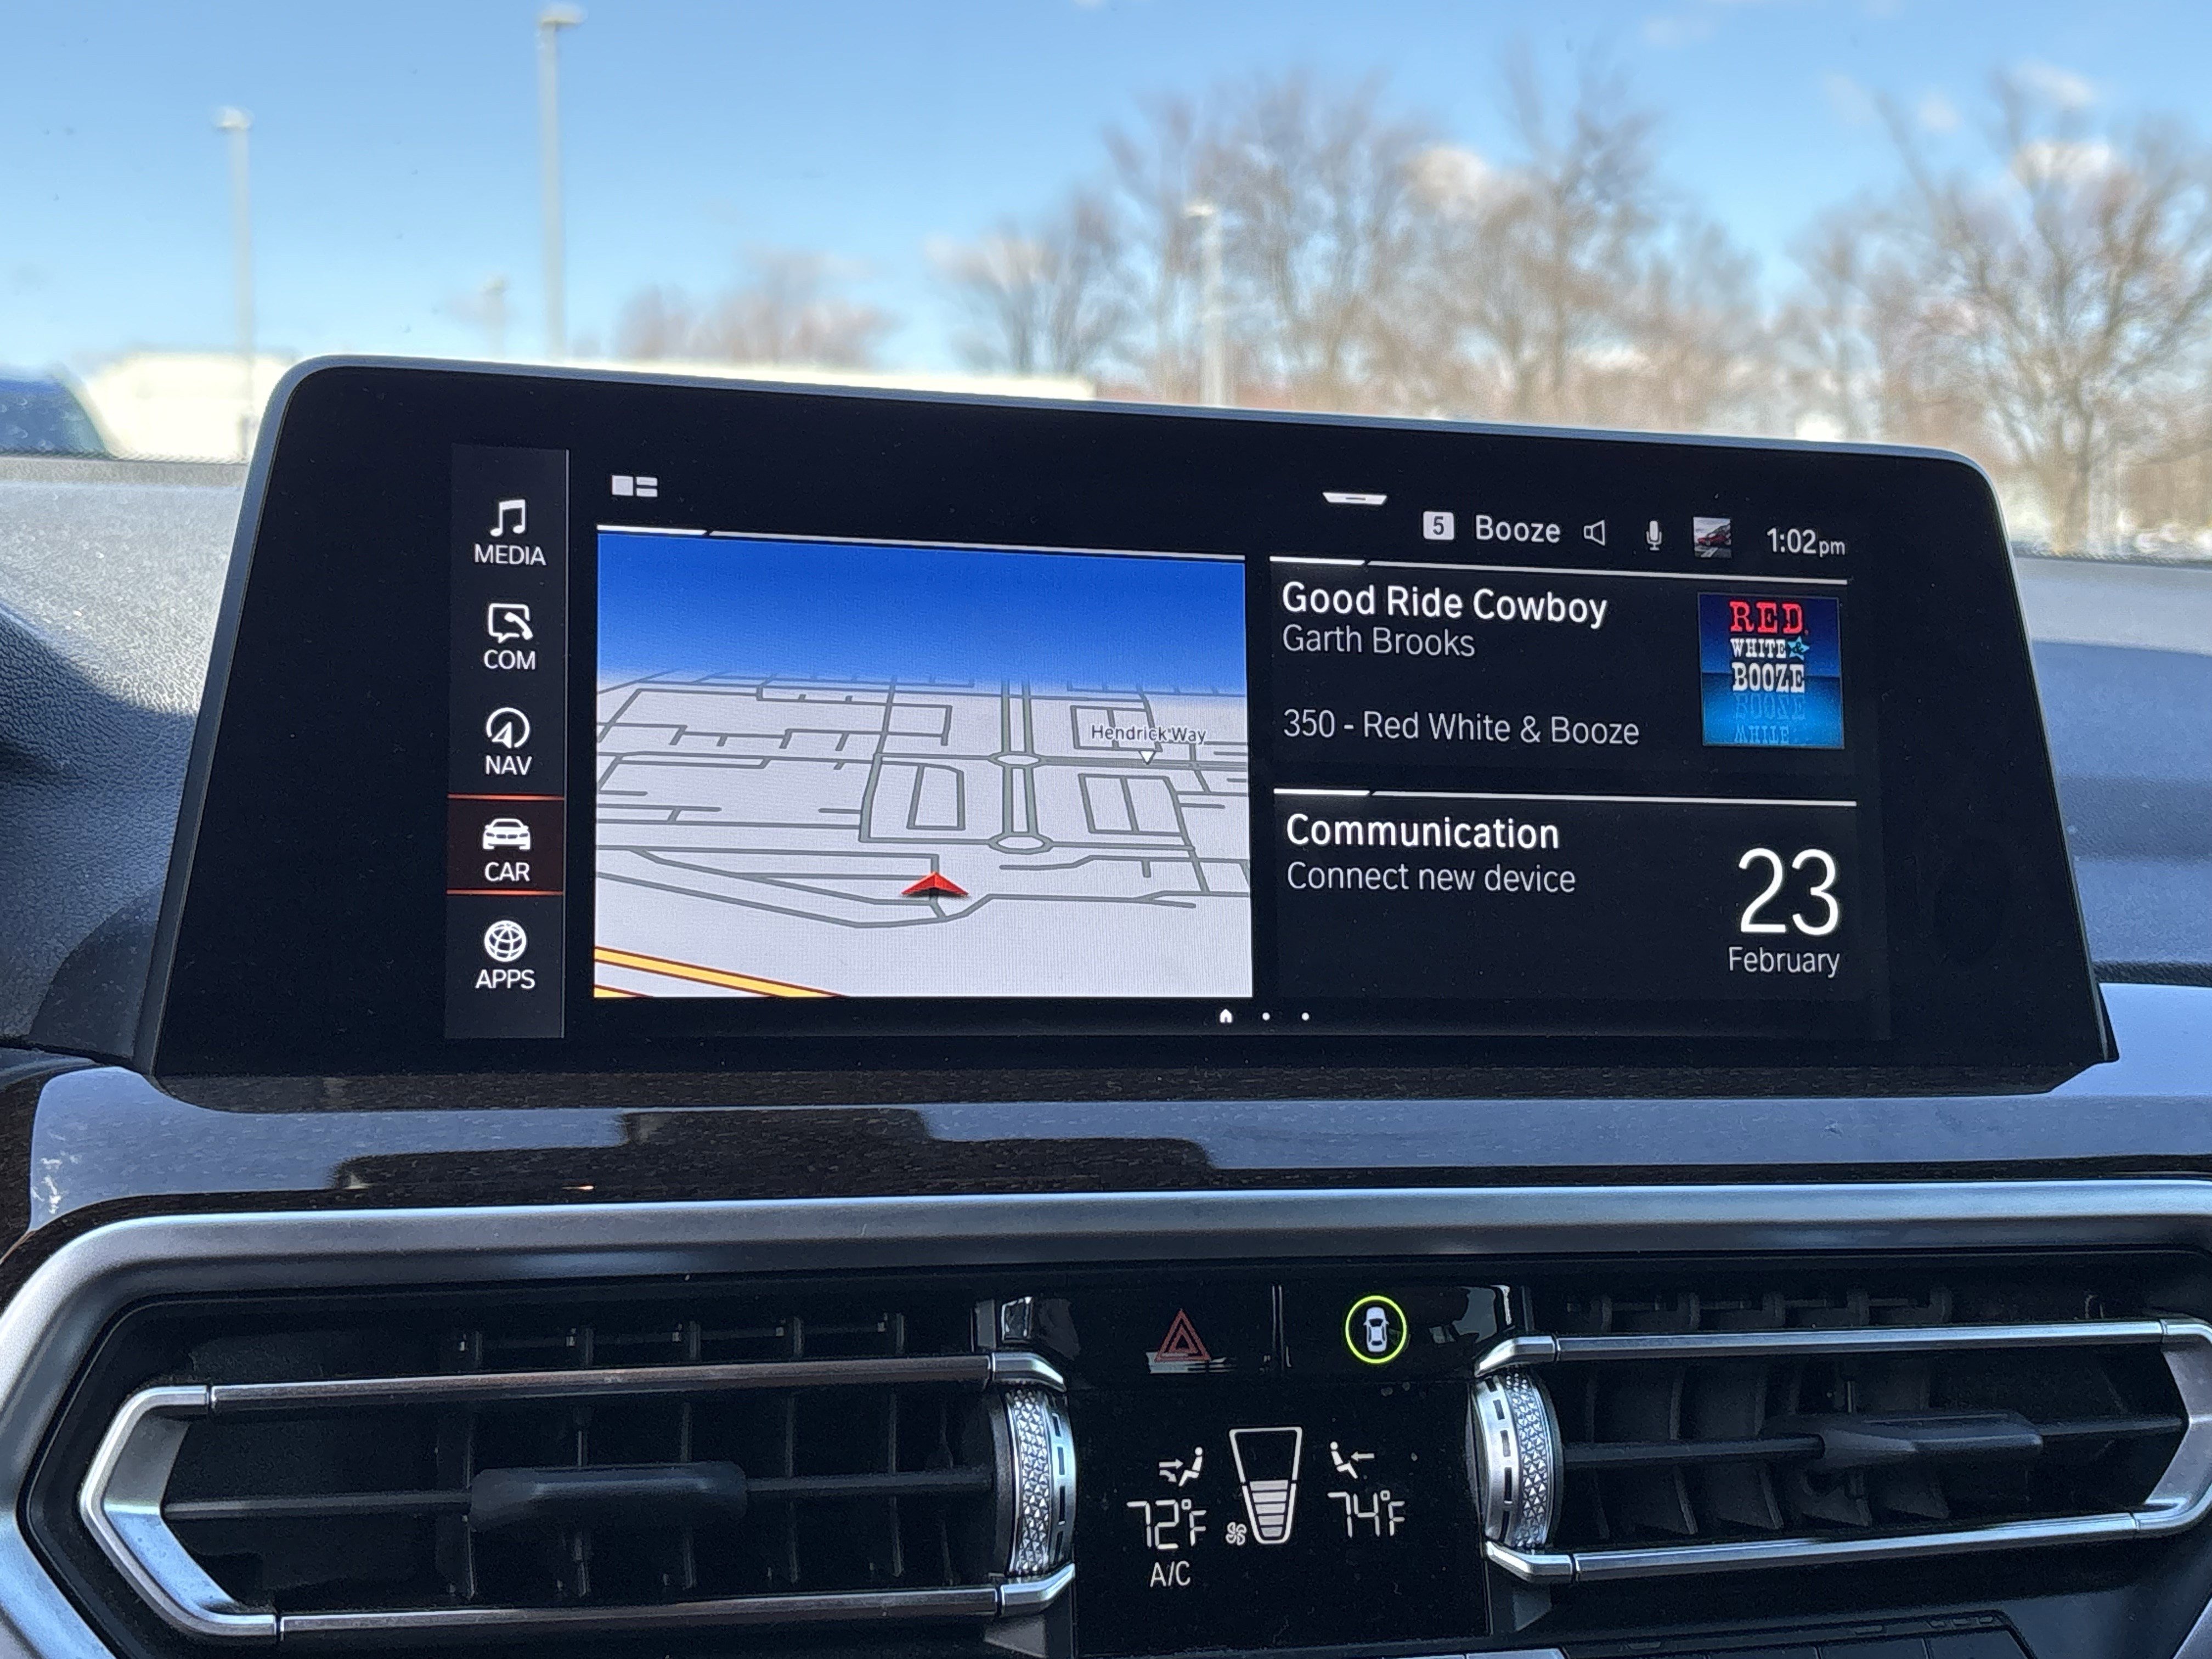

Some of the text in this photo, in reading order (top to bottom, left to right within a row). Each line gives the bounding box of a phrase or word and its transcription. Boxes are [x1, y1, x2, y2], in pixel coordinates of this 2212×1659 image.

[1433, 516, 1444, 535] 5
[1476, 515, 1560, 543] Booze
[475, 543, 546, 566] MEDIA
[1282, 581, 1607, 629] Good Ride Cowboy
[1283, 623, 1475, 657] Garth Brooks
[1730, 638, 1786, 658] WHITE
[483, 649, 535, 670] COM
[1731, 662, 1805, 693] BOOZE
[1092, 725, 1206, 743] Hendrick Way
[1284, 709, 1335, 738] 350
[1364, 710, 1418, 739] Red
[1428, 713, 1510, 742] White
[1520, 715, 1541, 743] &
[1551, 716, 1639, 745] Booze
[486, 754, 533, 775] NAV
[1286, 813, 1559, 849] Communication
[484, 861, 531, 882] CAR
[1288, 861, 1576, 893] Connect new device
[1738, 848, 1839, 936] 23
[1729, 946, 1840, 978] February
[475, 969, 535, 990] APPS
[1150, 1560, 1190, 1587] A/C
